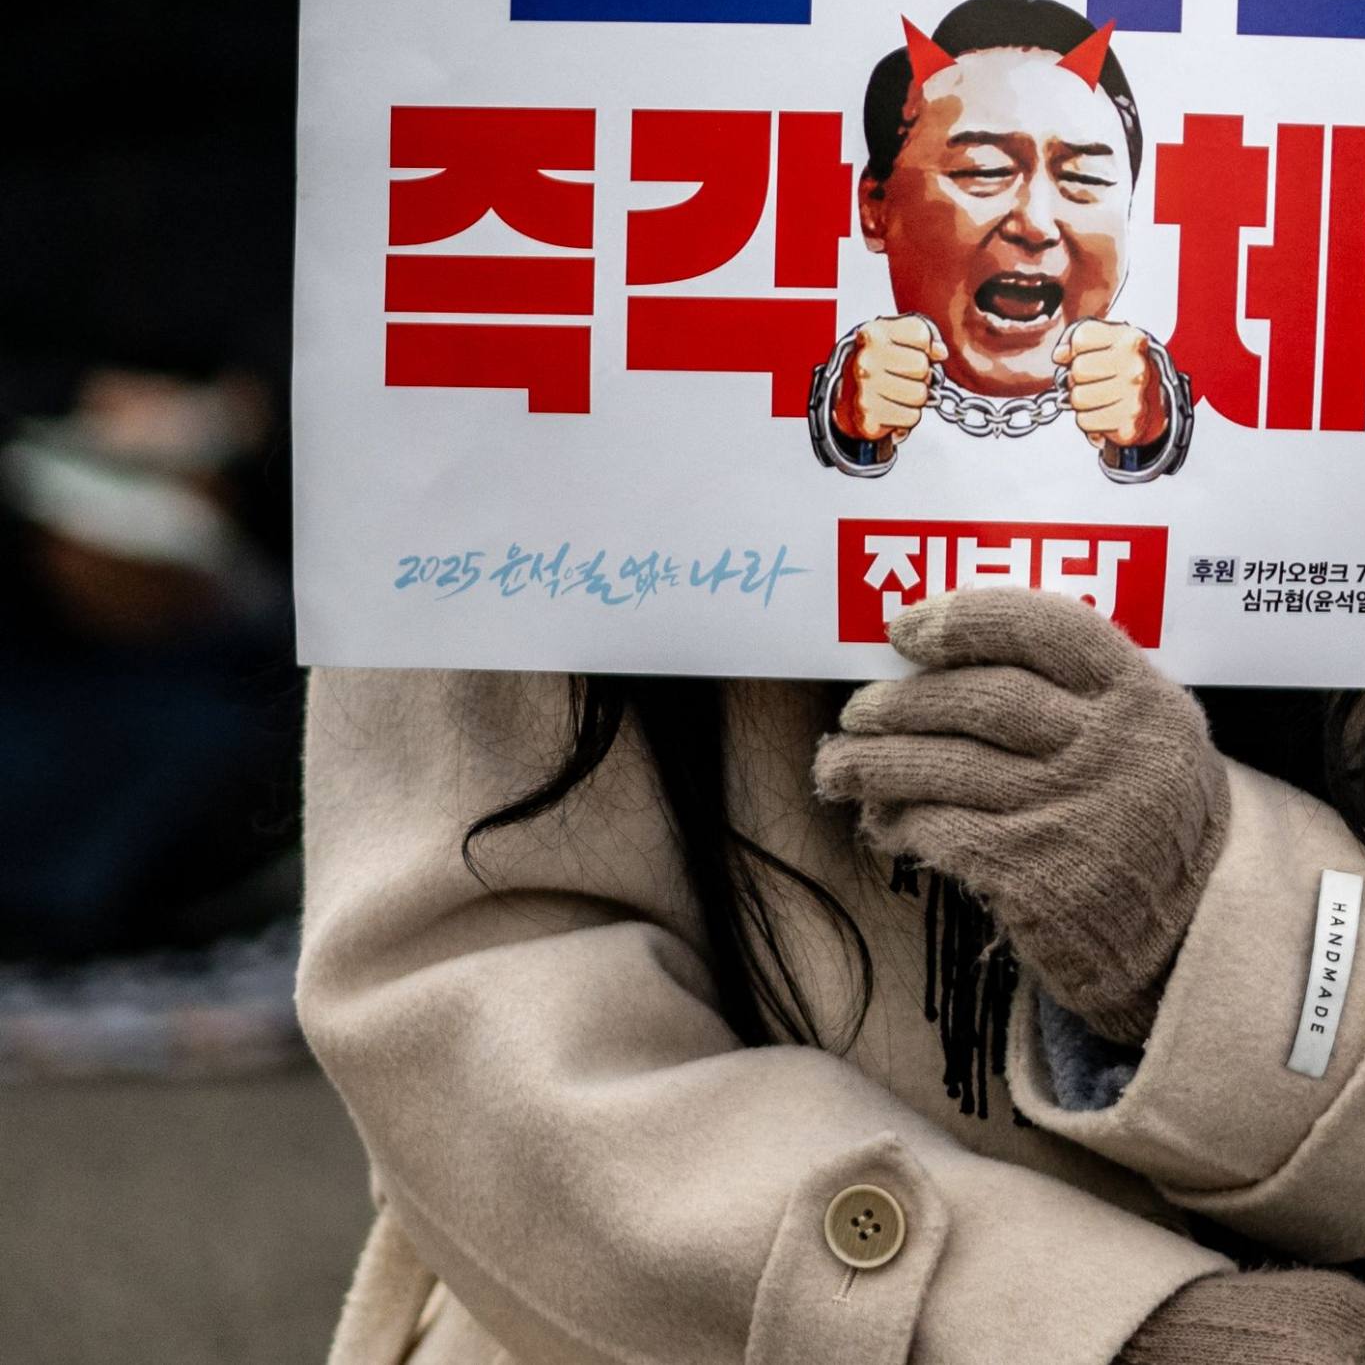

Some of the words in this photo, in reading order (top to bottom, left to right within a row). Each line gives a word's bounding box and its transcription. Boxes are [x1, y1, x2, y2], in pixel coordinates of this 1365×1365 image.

[385, 106, 852, 418] 즉각
[394, 550, 486, 601] 2025
[489, 541, 634, 606] 윤석열
[619, 550, 682, 609] 없는
[689, 544, 814, 609] 나라
[1192, 558, 1236, 584] 후원
[1243, 560, 1349, 585] 카카오뱅크
[1309, 901, 1347, 1035] HANDMADE
